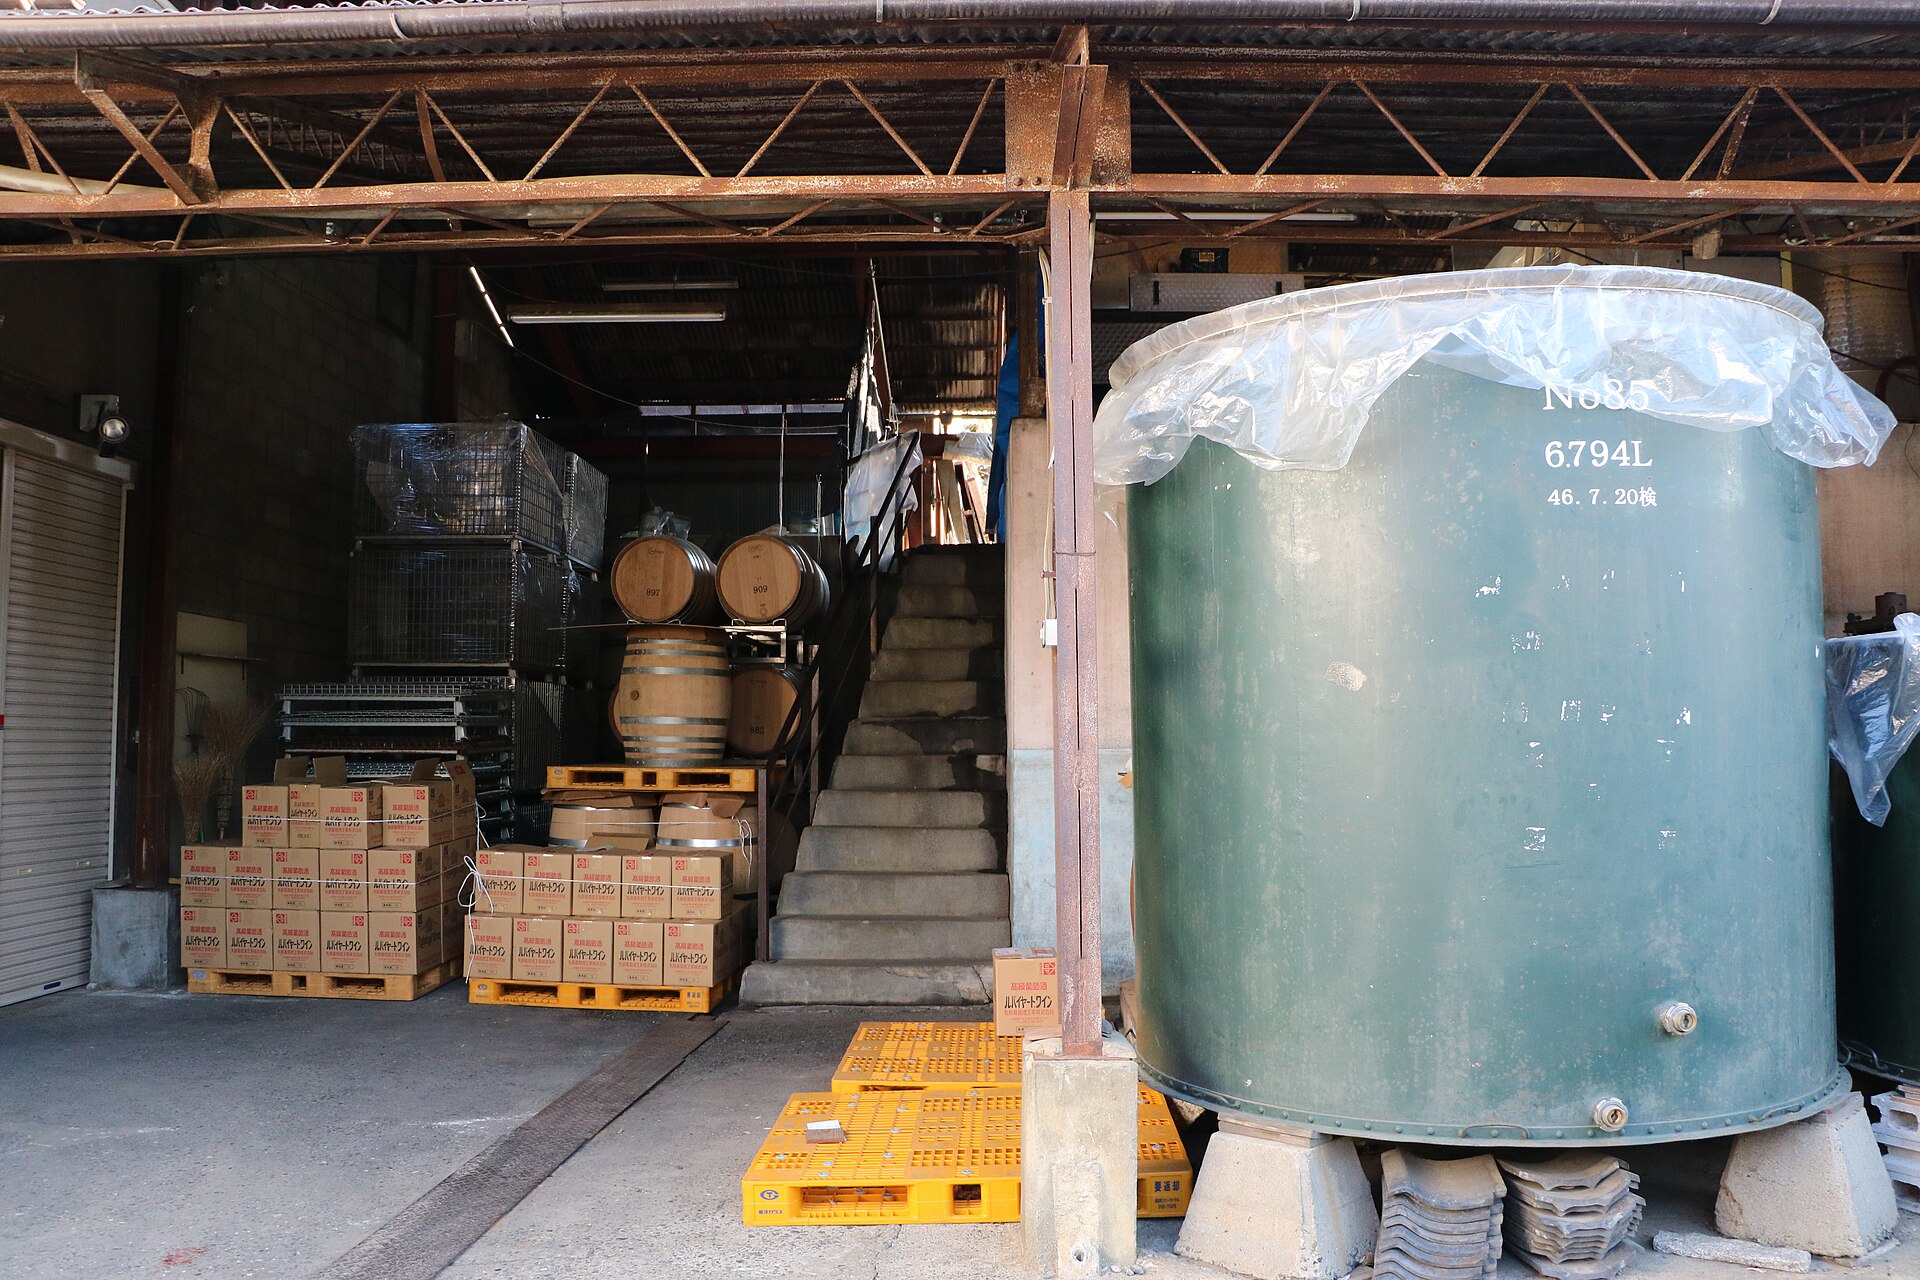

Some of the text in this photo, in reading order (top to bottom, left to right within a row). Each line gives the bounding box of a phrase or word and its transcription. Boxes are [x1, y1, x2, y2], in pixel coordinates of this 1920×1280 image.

[1005, 996, 1051, 1008] ルバイヤートワイン
